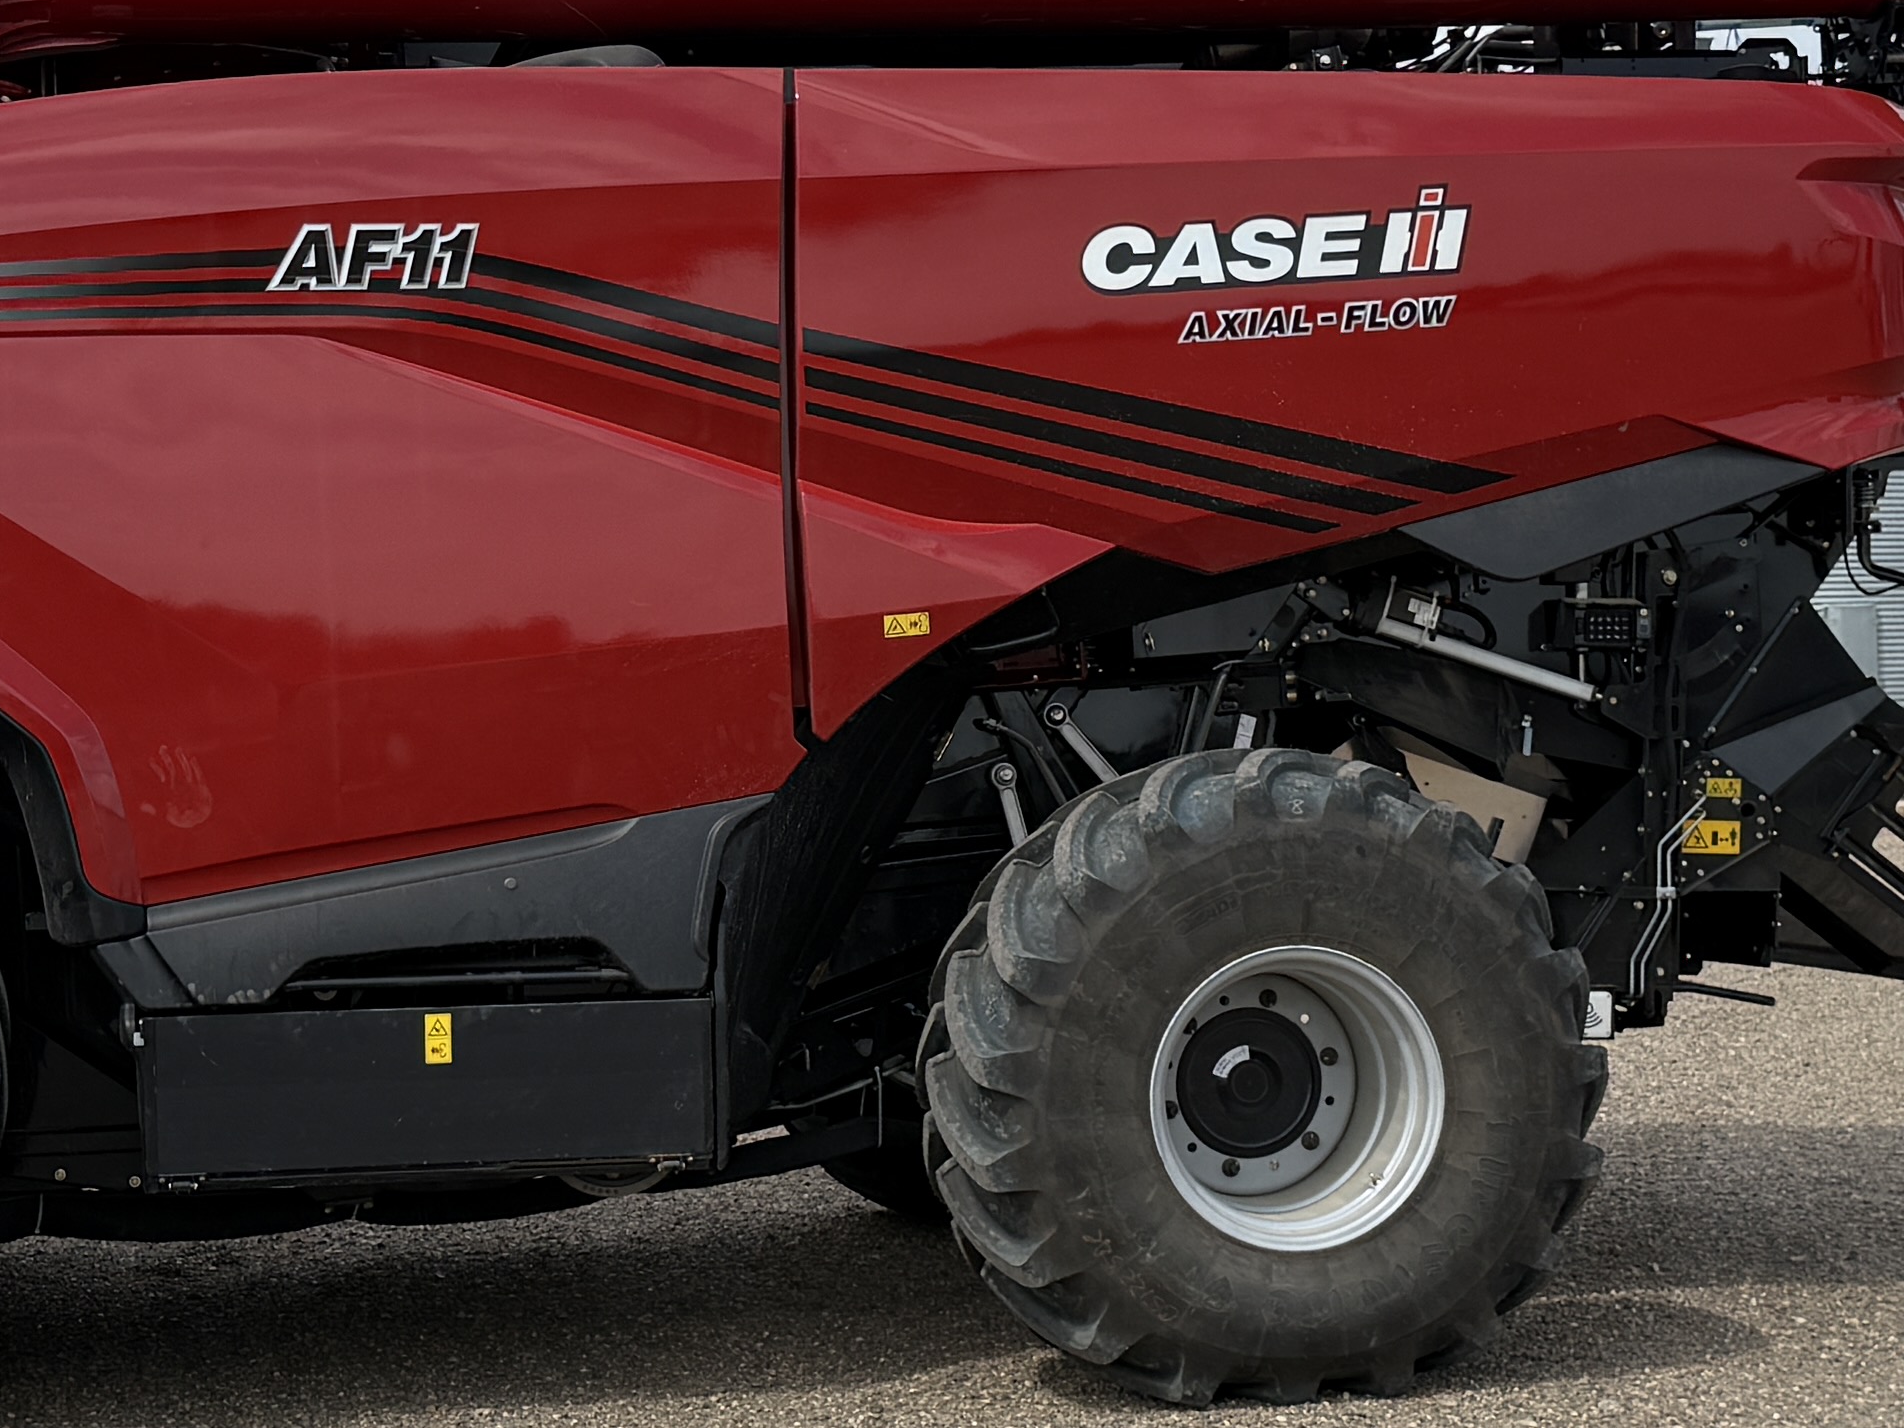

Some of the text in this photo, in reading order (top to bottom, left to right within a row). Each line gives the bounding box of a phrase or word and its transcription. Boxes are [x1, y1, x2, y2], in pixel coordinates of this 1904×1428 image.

[265, 223, 480, 291] AF11
[1081, 186, 1470, 292] CASE IH
[1177, 295, 1458, 344] AXIAL-FLOW
